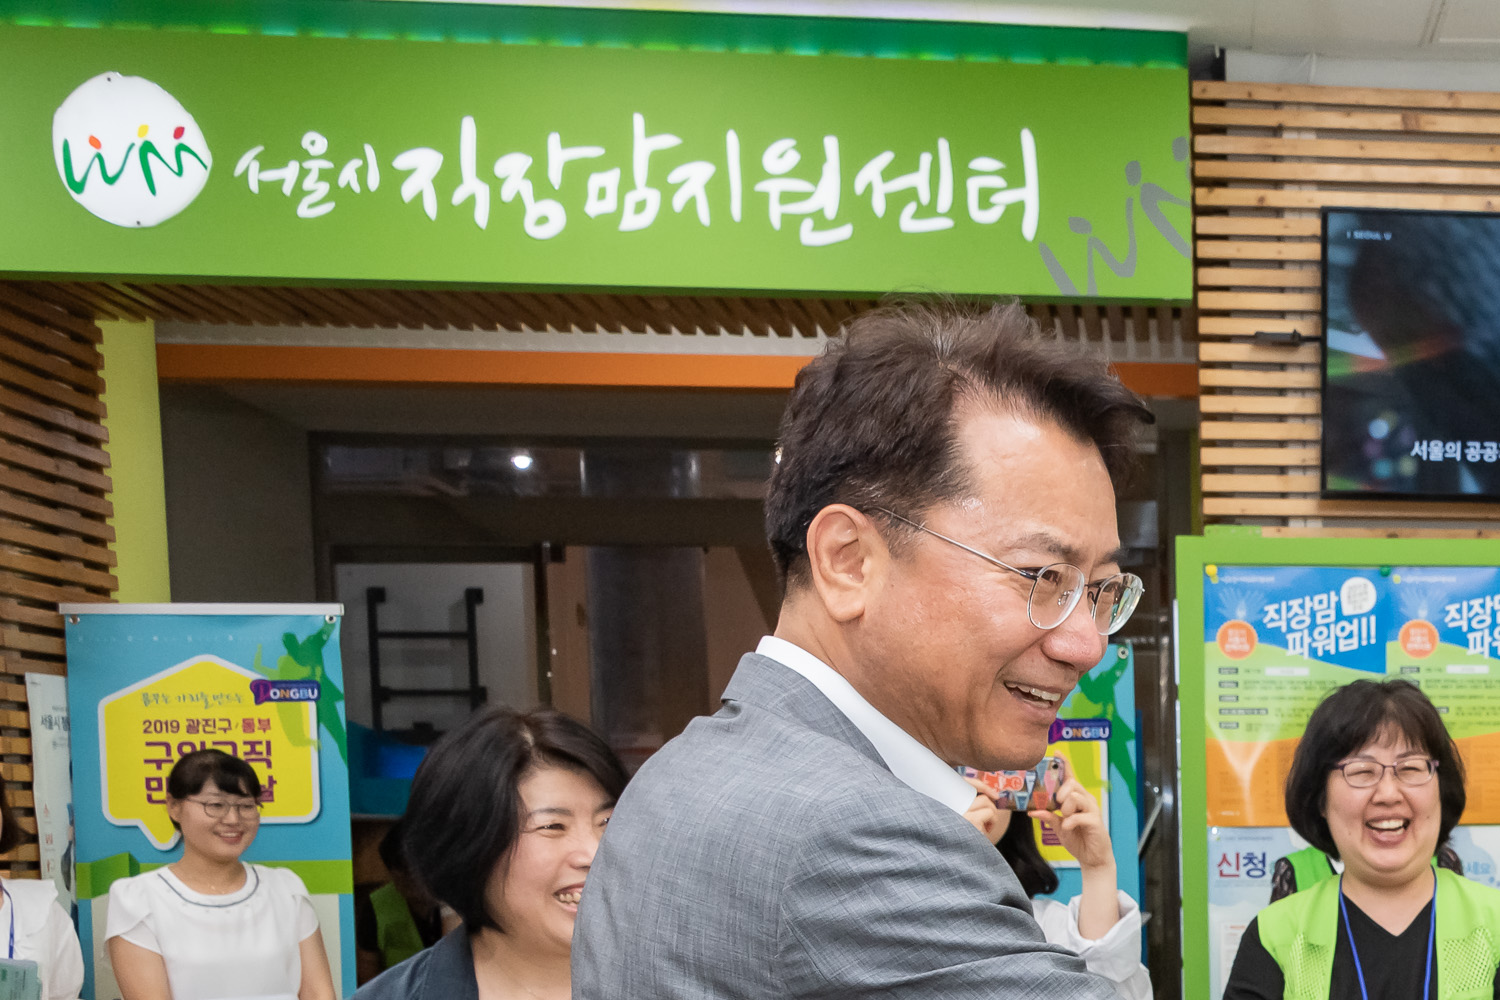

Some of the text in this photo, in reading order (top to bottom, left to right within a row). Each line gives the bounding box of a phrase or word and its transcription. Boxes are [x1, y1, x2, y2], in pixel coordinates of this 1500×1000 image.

[236, 113, 1041, 246] 서울시 직장맘지원센터
[1410, 440, 1462, 463] 서울의
[1262, 591, 1339, 633] 직장맘
[1286, 615, 1377, 660] 파워업!!
[142, 719, 180, 734] 2019
[186, 718, 232, 734] 광진구
